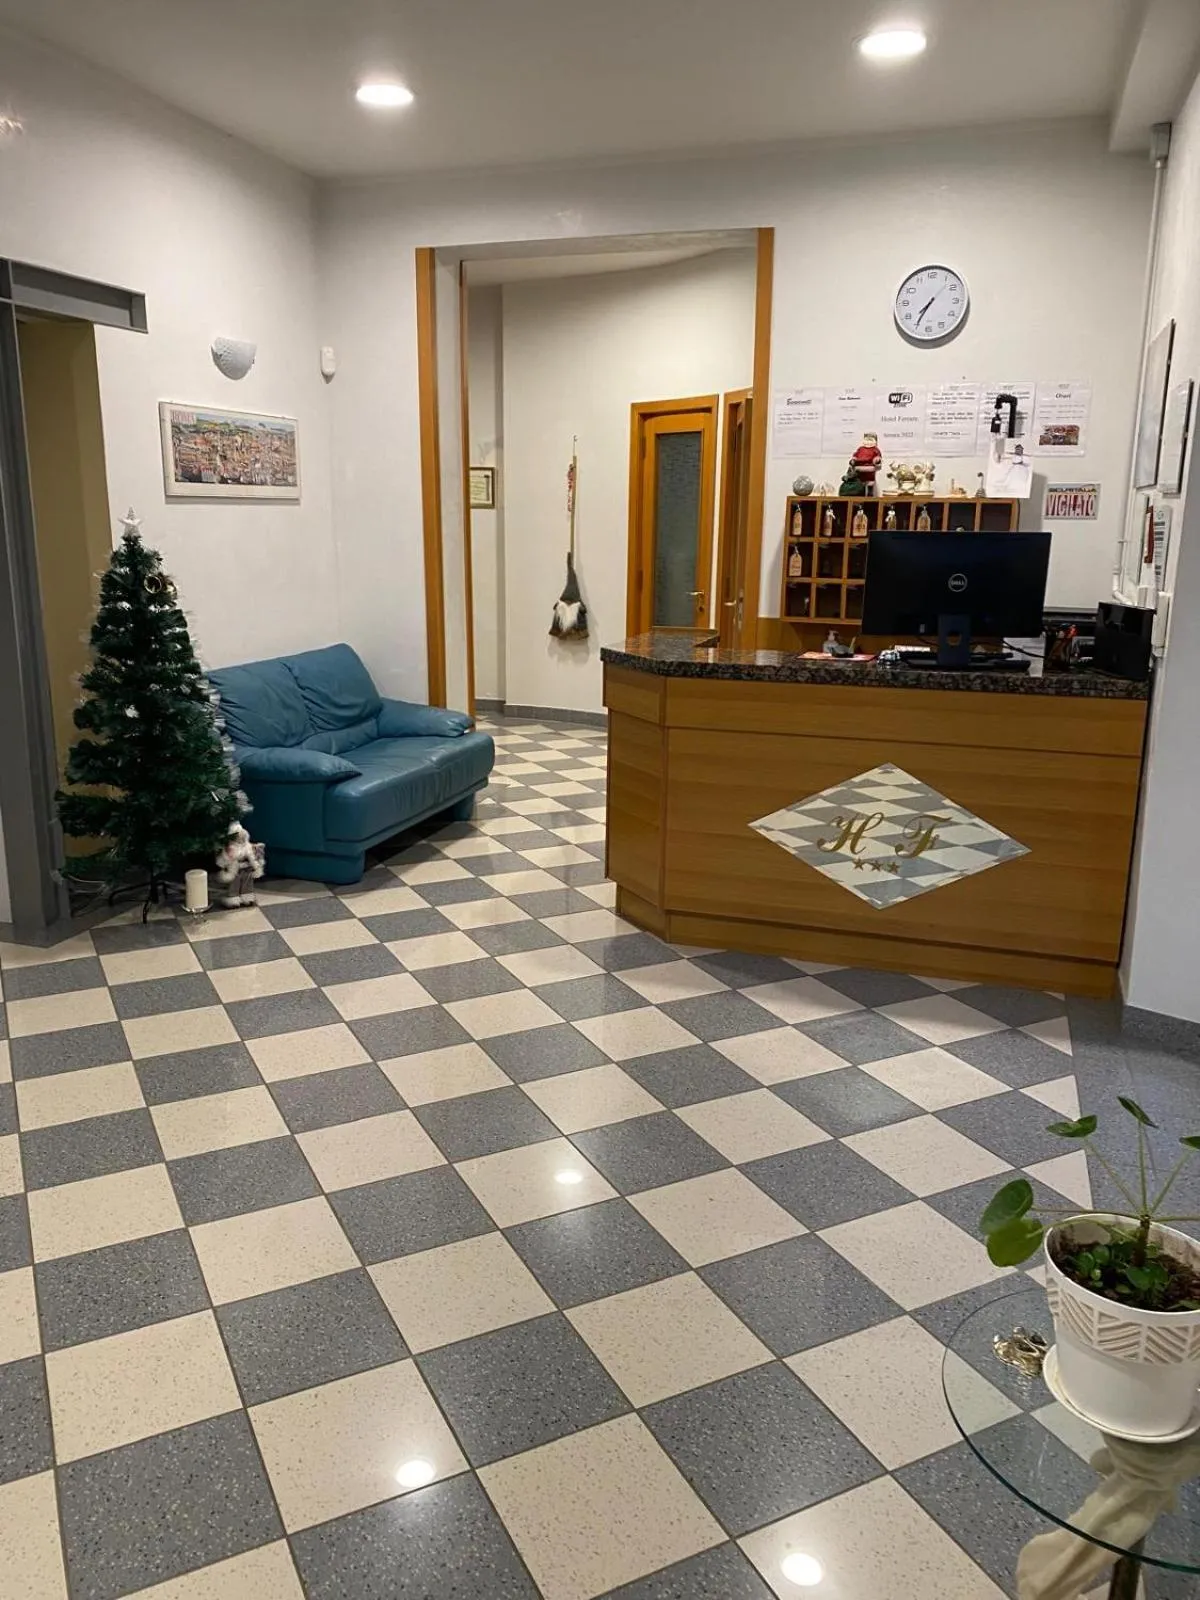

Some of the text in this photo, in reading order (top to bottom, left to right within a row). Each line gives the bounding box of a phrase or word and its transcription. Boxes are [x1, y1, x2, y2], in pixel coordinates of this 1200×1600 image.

[928, 271, 937, 279] 12
[1045, 494, 1097, 516] VIGILATO
[816, 811, 953, 859] H F
